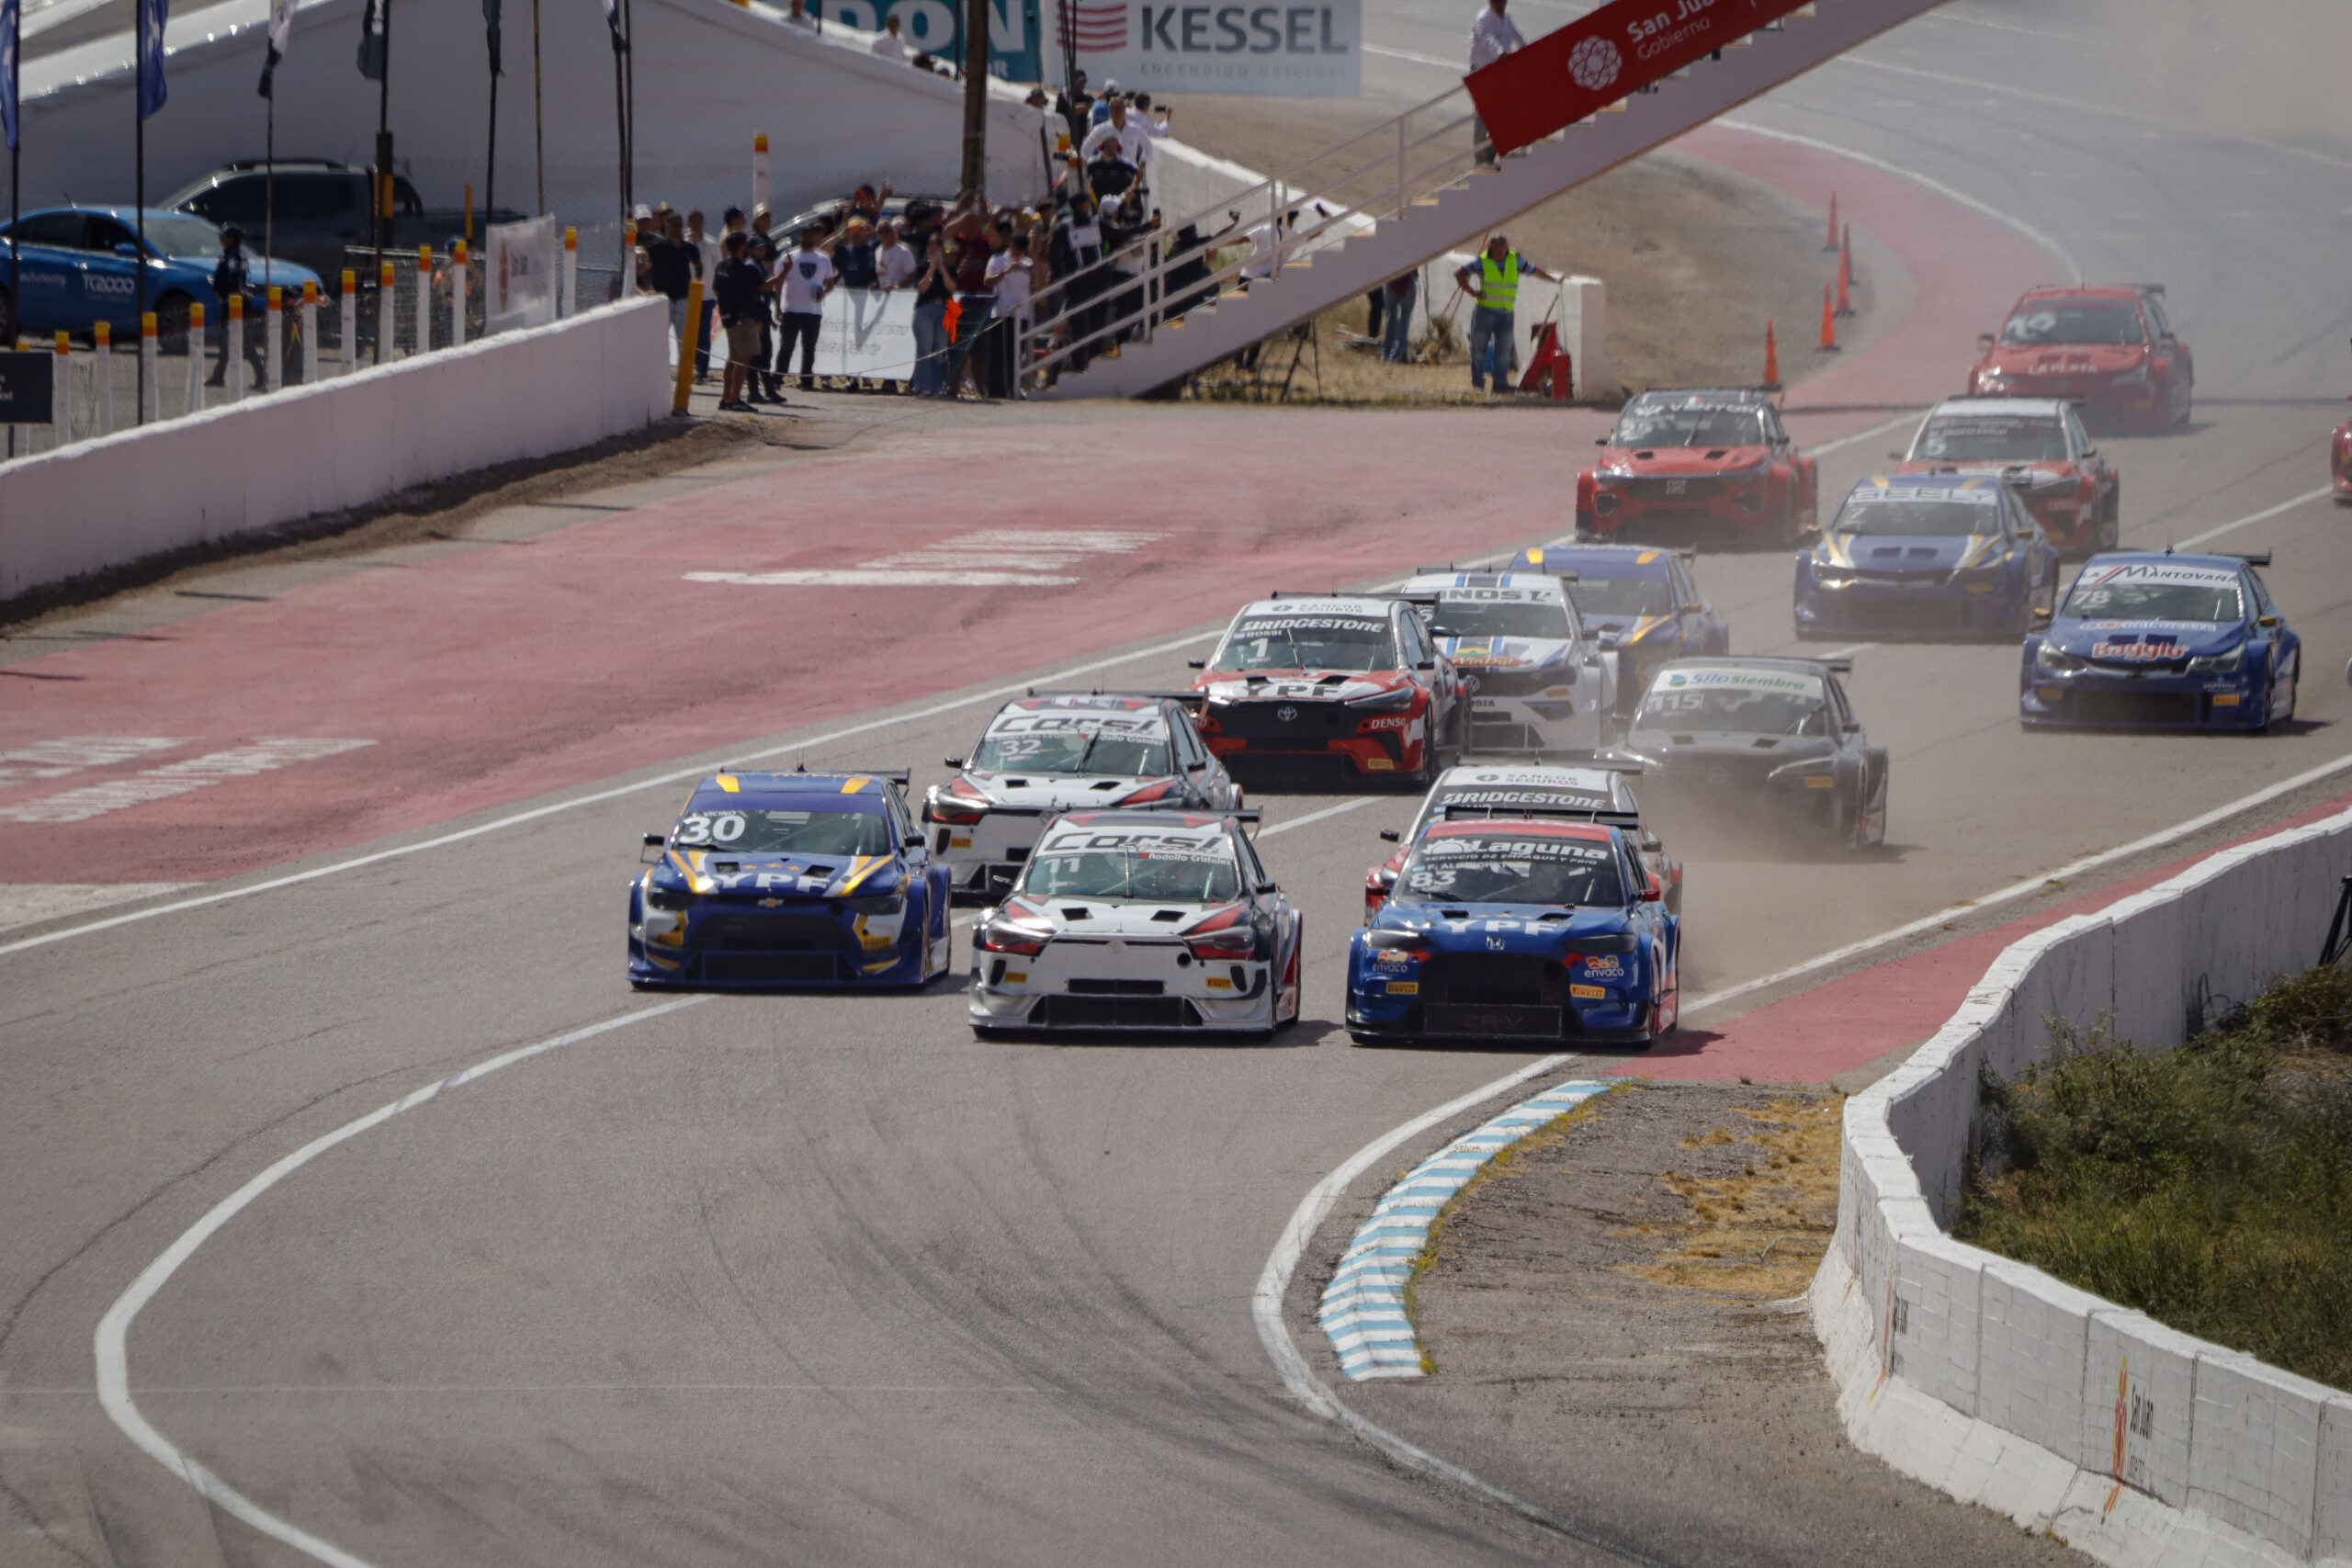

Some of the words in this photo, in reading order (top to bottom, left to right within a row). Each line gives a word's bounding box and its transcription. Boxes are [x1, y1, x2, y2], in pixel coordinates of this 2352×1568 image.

[1142, 6, 1349, 54] KESSEL
[1627, 11, 1671, 43] San
[1637, 16, 1711, 61] Gobierno
[1141, 64, 1248, 77] ENCENDIDO
[1850, 488, 1993, 502] GEELY
[2074, 590, 2111, 605] 78
[1241, 618, 1385, 633] BRIDGESTONE
[1247, 630, 1283, 638] ROSSI
[1250, 637, 1269, 659] 1
[1242, 684, 1340, 697] YPF
[1645, 693, 1702, 714] 115
[992, 715, 1159, 733] Corsi
[1371, 717, 1406, 729] DENSO
[999, 739, 1042, 757] 32
[1126, 736, 1164, 746] Cristales
[1441, 791, 1606, 811] BRIDGESTONE
[679, 815, 746, 844] 30
[1043, 831, 1222, 852] Corsi
[1148, 852, 1187, 862] Rodolfo
[1191, 855, 1231, 865] Cristales
[1470, 840, 1609, 861] Laguna
[1044, 857, 1080, 874] 11
[715, 873, 831, 893] YPF
[1408, 870, 1457, 888] 83
[1440, 919, 1558, 936] YPF
[1373, 963, 1408, 974] envaco
[1584, 966, 1624, 978] envaco
[1388, 985, 1416, 994] PIRELLI
[1572, 987, 1603, 998] PIRELLI
